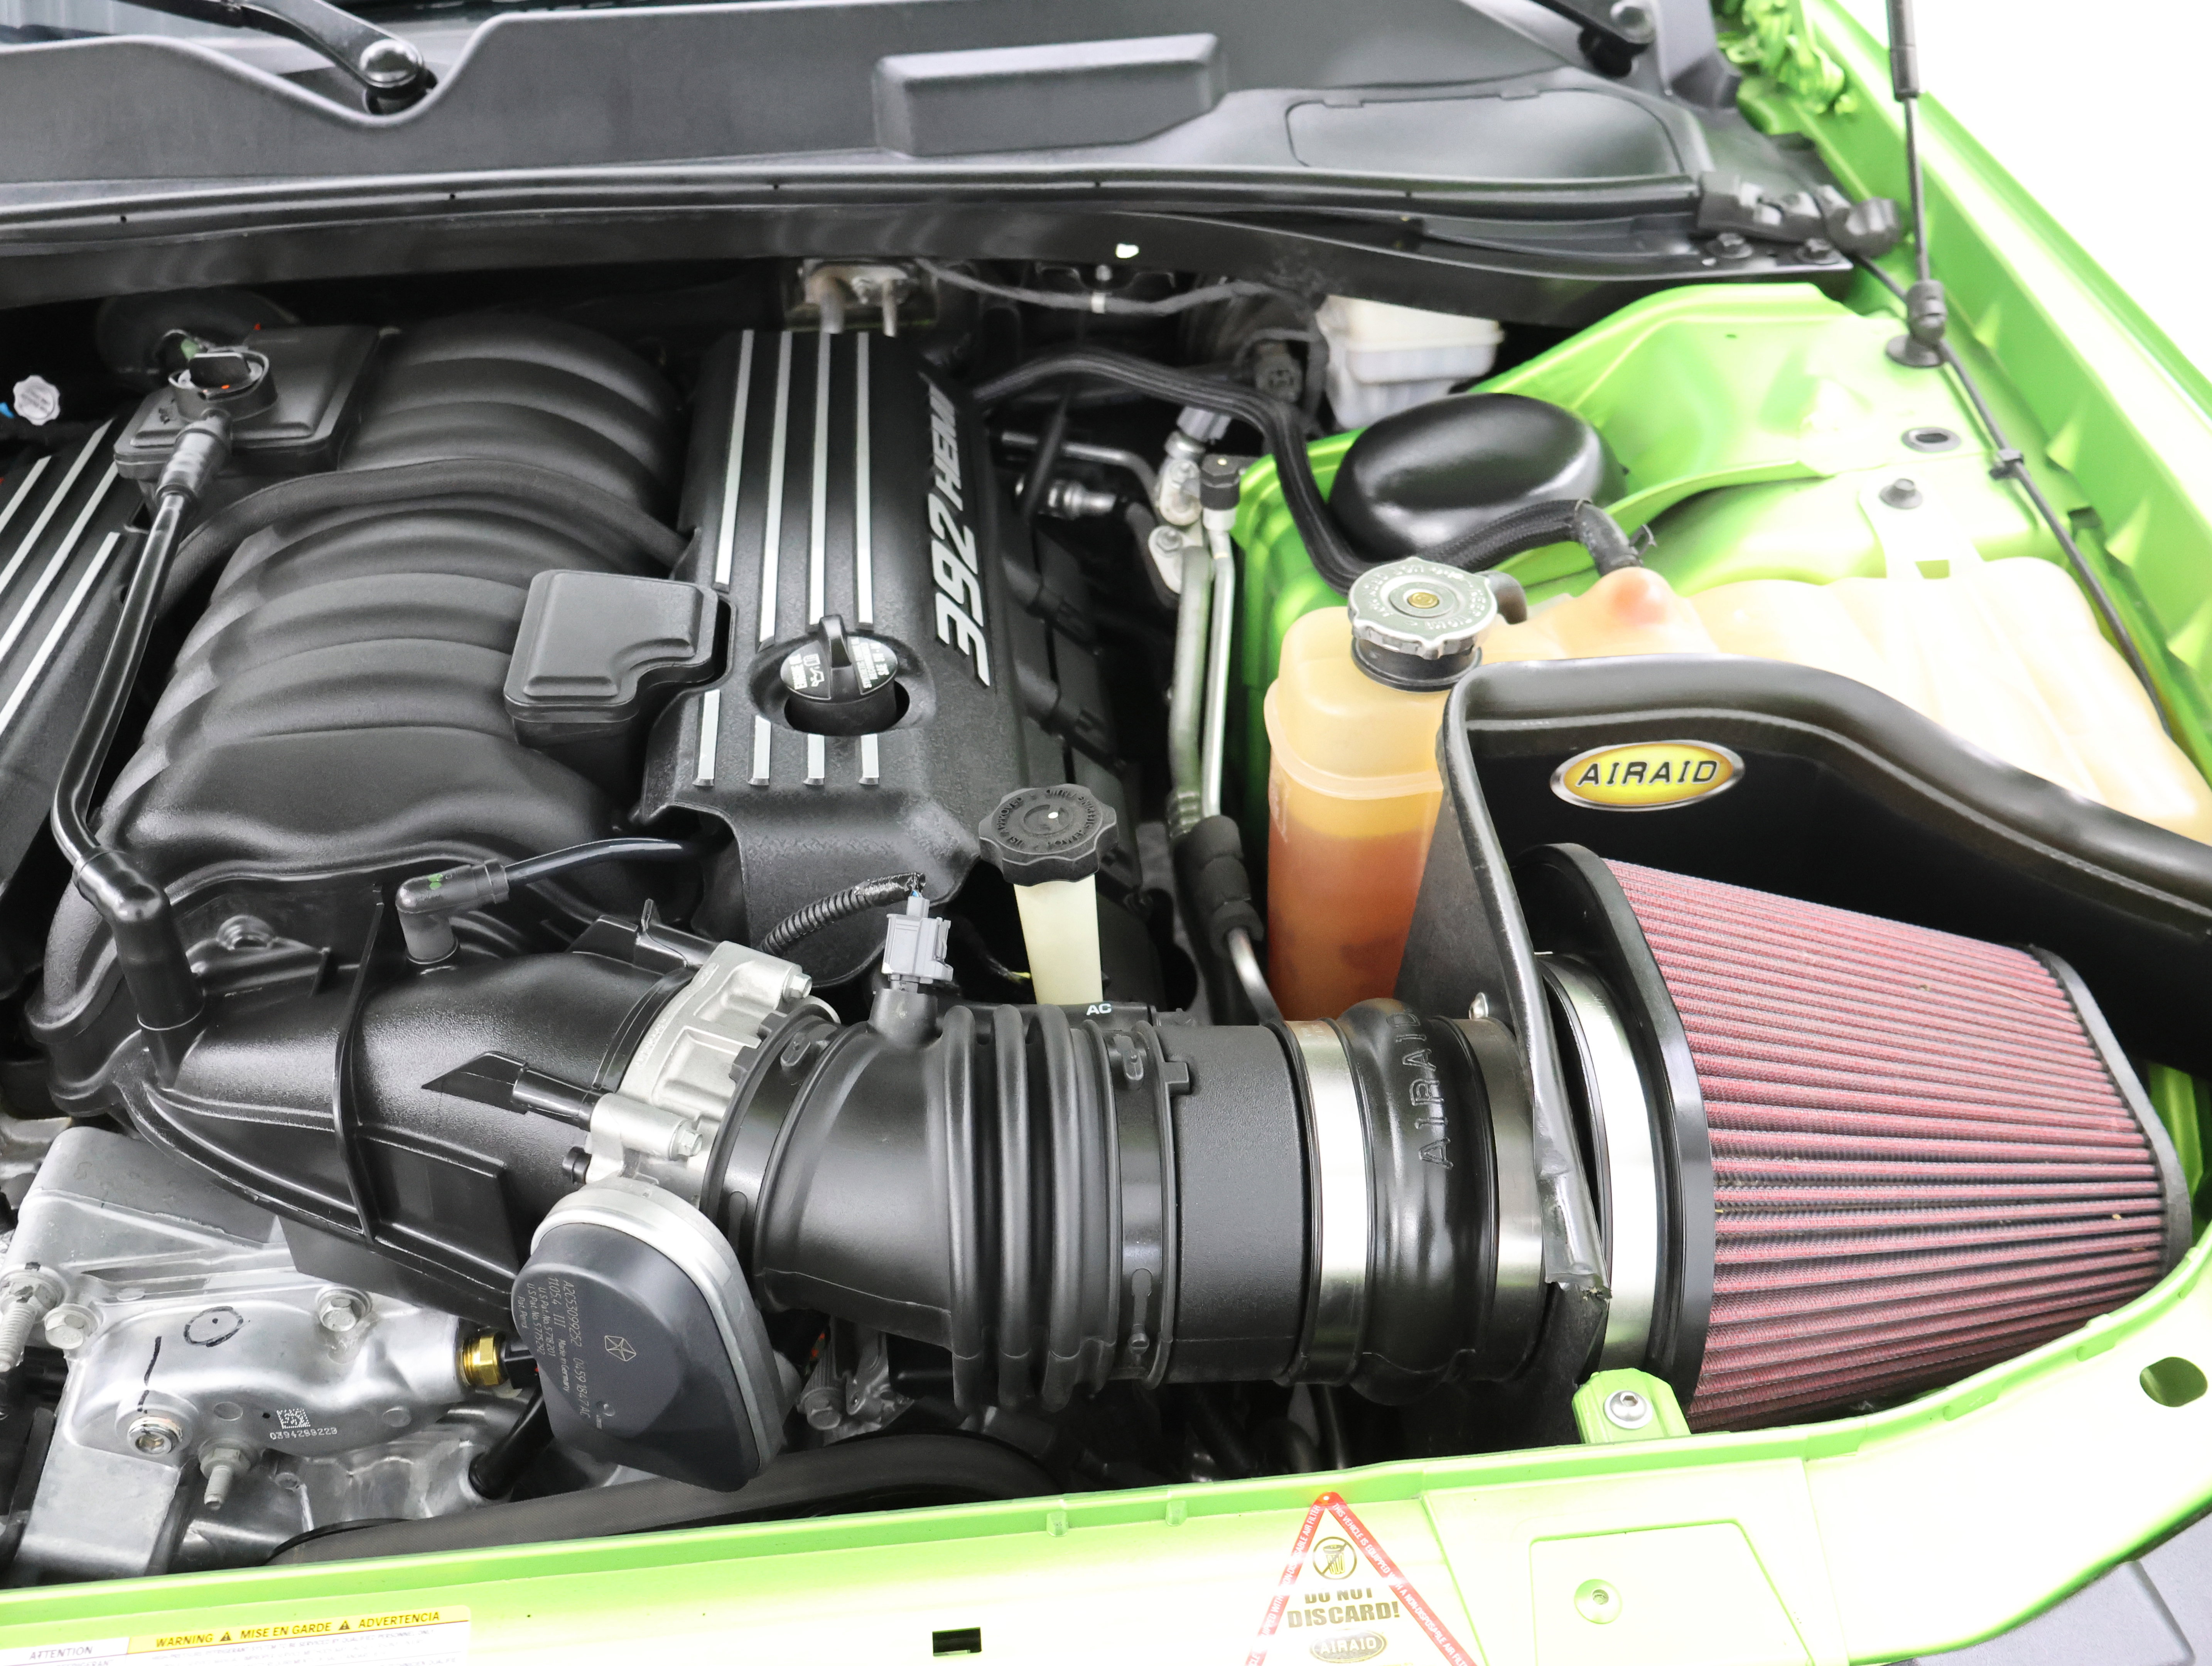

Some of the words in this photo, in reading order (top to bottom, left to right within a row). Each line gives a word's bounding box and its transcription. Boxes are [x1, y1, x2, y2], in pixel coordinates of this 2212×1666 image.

[928, 383, 963, 511] HEMI
[928, 492, 990, 687] 392
[876, 663, 890, 676] SAE
[1575, 760, 1720, 787] AIRAID
[1086, 1003, 1112, 1016] AC
[1386, 1013, 1454, 1170] AIRAID
[1307, 1505, 1321, 1524] FILTER
[1303, 1524, 1313, 1536] AIR
[1332, 1503, 1344, 1517] THIS
[1342, 1516, 1363, 1539] VEHICLE
[1365, 1544, 1390, 1573] EQUIPPED
[1404, 1594, 1447, 1644] NON-DISPOSABLE
[1443, 1643, 1456, 1655] AIR
[1452, 1653, 1468, 1666] FILT
[1287, 1600, 1401, 1628] DISCARD!
[156, 1634, 213, 1647] WARNING
[240, 1628, 269, 1639] MISE
[272, 1626, 288, 1636] EN
[292, 1622, 331, 1634] GARDE
[358, 1612, 440, 1628] ADVERTENCIA
[29, 1646, 93, 1660] ATTENTION
[1320, 1637, 1377, 1654] AIRAID
